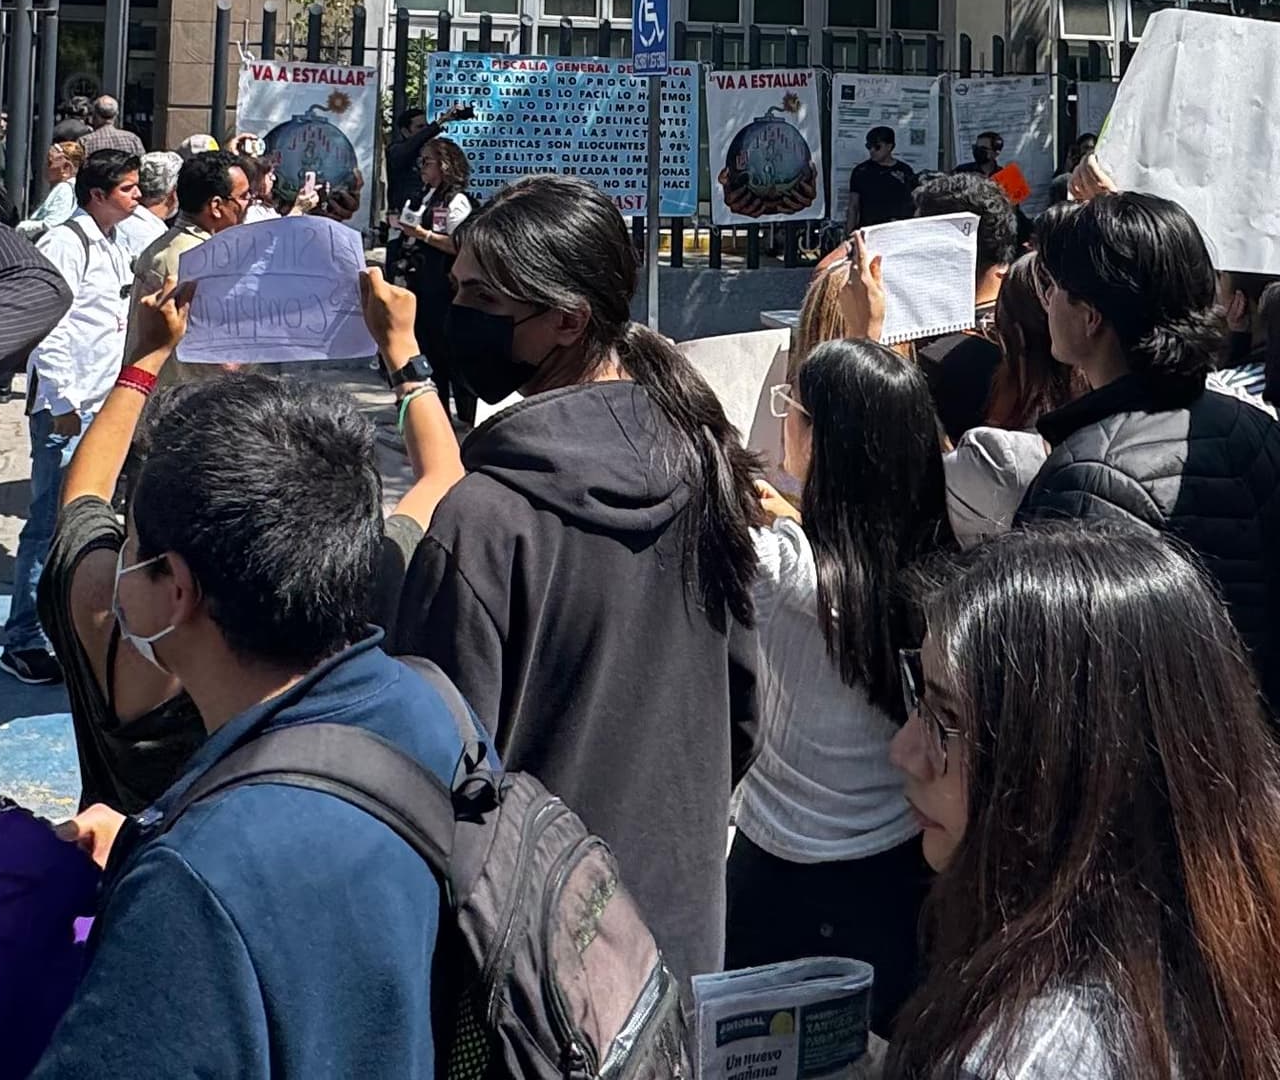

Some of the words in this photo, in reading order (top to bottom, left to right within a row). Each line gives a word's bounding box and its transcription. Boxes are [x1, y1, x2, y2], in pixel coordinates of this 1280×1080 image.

[457, 59, 485, 69] ESTA
[491, 60, 548, 71] FISCALIA
[555, 62, 611, 74] GENERAL
[277, 66, 289, 82] A
[435, 72, 548, 85] PROCURAMOS
[557, 76, 577, 86] NO
[738, 75, 748, 89] A
[434, 85, 492, 95] NUESTRO
[499, 87, 531, 97] LEMA
[538, 88, 551, 98] ES
[558, 89, 573, 98] LO
[580, 90, 611, 99] FACIL
[617, 91, 632, 100] LO
[502, 100, 510, 109] Y
[519, 101, 536, 110] LO
[545, 101, 600, 112] DIFICIL
[608, 103, 691, 114] IMPOBLE.
[522, 114, 557, 123] PARA
[565, 115, 588, 124] LOS
[439, 126, 525, 136] NJUSTICIA
[534, 127, 573, 137] PARA
[582, 128, 607, 137] LAS
[615, 128, 691, 139] VICTMAS.
[462, 139, 541, 149] ESTADISTICAS
[547, 140, 571, 149] SON
[578, 140, 646, 151] ELOCUENTES
[669, 142, 691, 152] 98%
[467, 151, 486, 161] OS
[495, 152, 553, 162] DELITOS
[561, 154, 619, 164] QUEDAN
[478, 165, 492, 174] SE
[562, 166, 577, 175] DE
[579, 166, 610, 176] CADA
[613, 167, 634, 176] 100
[603, 180, 620, 189] NO
[624, 180, 637, 189] SE
[663, 180, 691, 190] HACE
[726, 1053, 742, 1071] Un
[743, 1049, 783, 1066] nuevo
